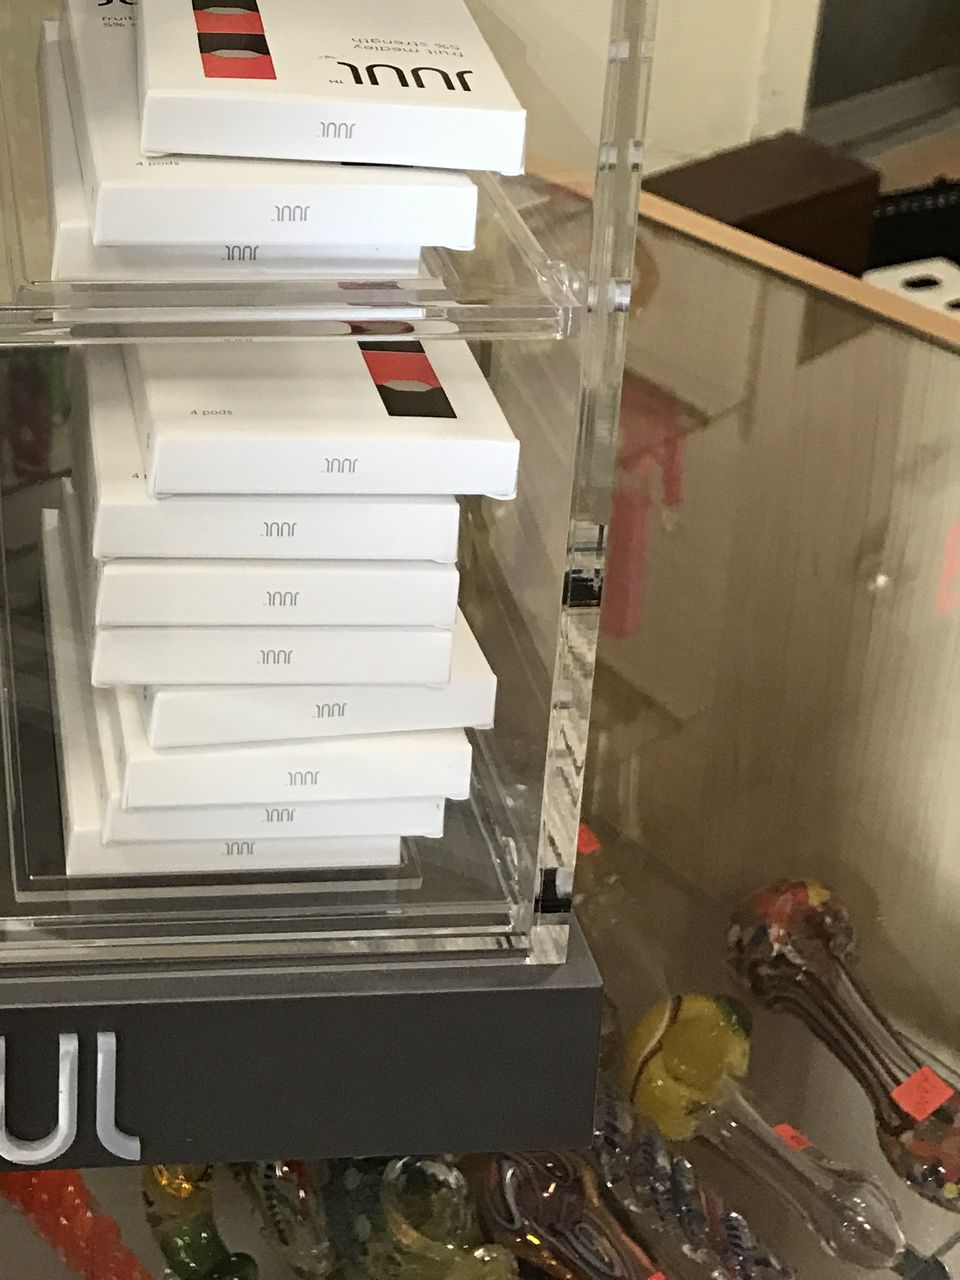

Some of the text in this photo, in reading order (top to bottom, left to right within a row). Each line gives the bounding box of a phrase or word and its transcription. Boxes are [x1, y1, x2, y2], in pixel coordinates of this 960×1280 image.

[336, 60, 474, 93] JUUL
[319, 121, 356, 139] JUUL
[273, 204, 310, 223] JUUL
[223, 245, 259, 262] JUUL
[201, 407, 234, 418] pods
[324, 457, 359, 474] JUUL
[263, 521, 297, 538] JUUL
[266, 590, 300, 607] JUUL
[260, 649, 294, 665] JUUL
[315, 702, 348, 719] JUUL
[287, 770, 320, 787] JUUL
[264, 808, 294, 823] JUUL
[225, 840, 255, 856] JUUL
